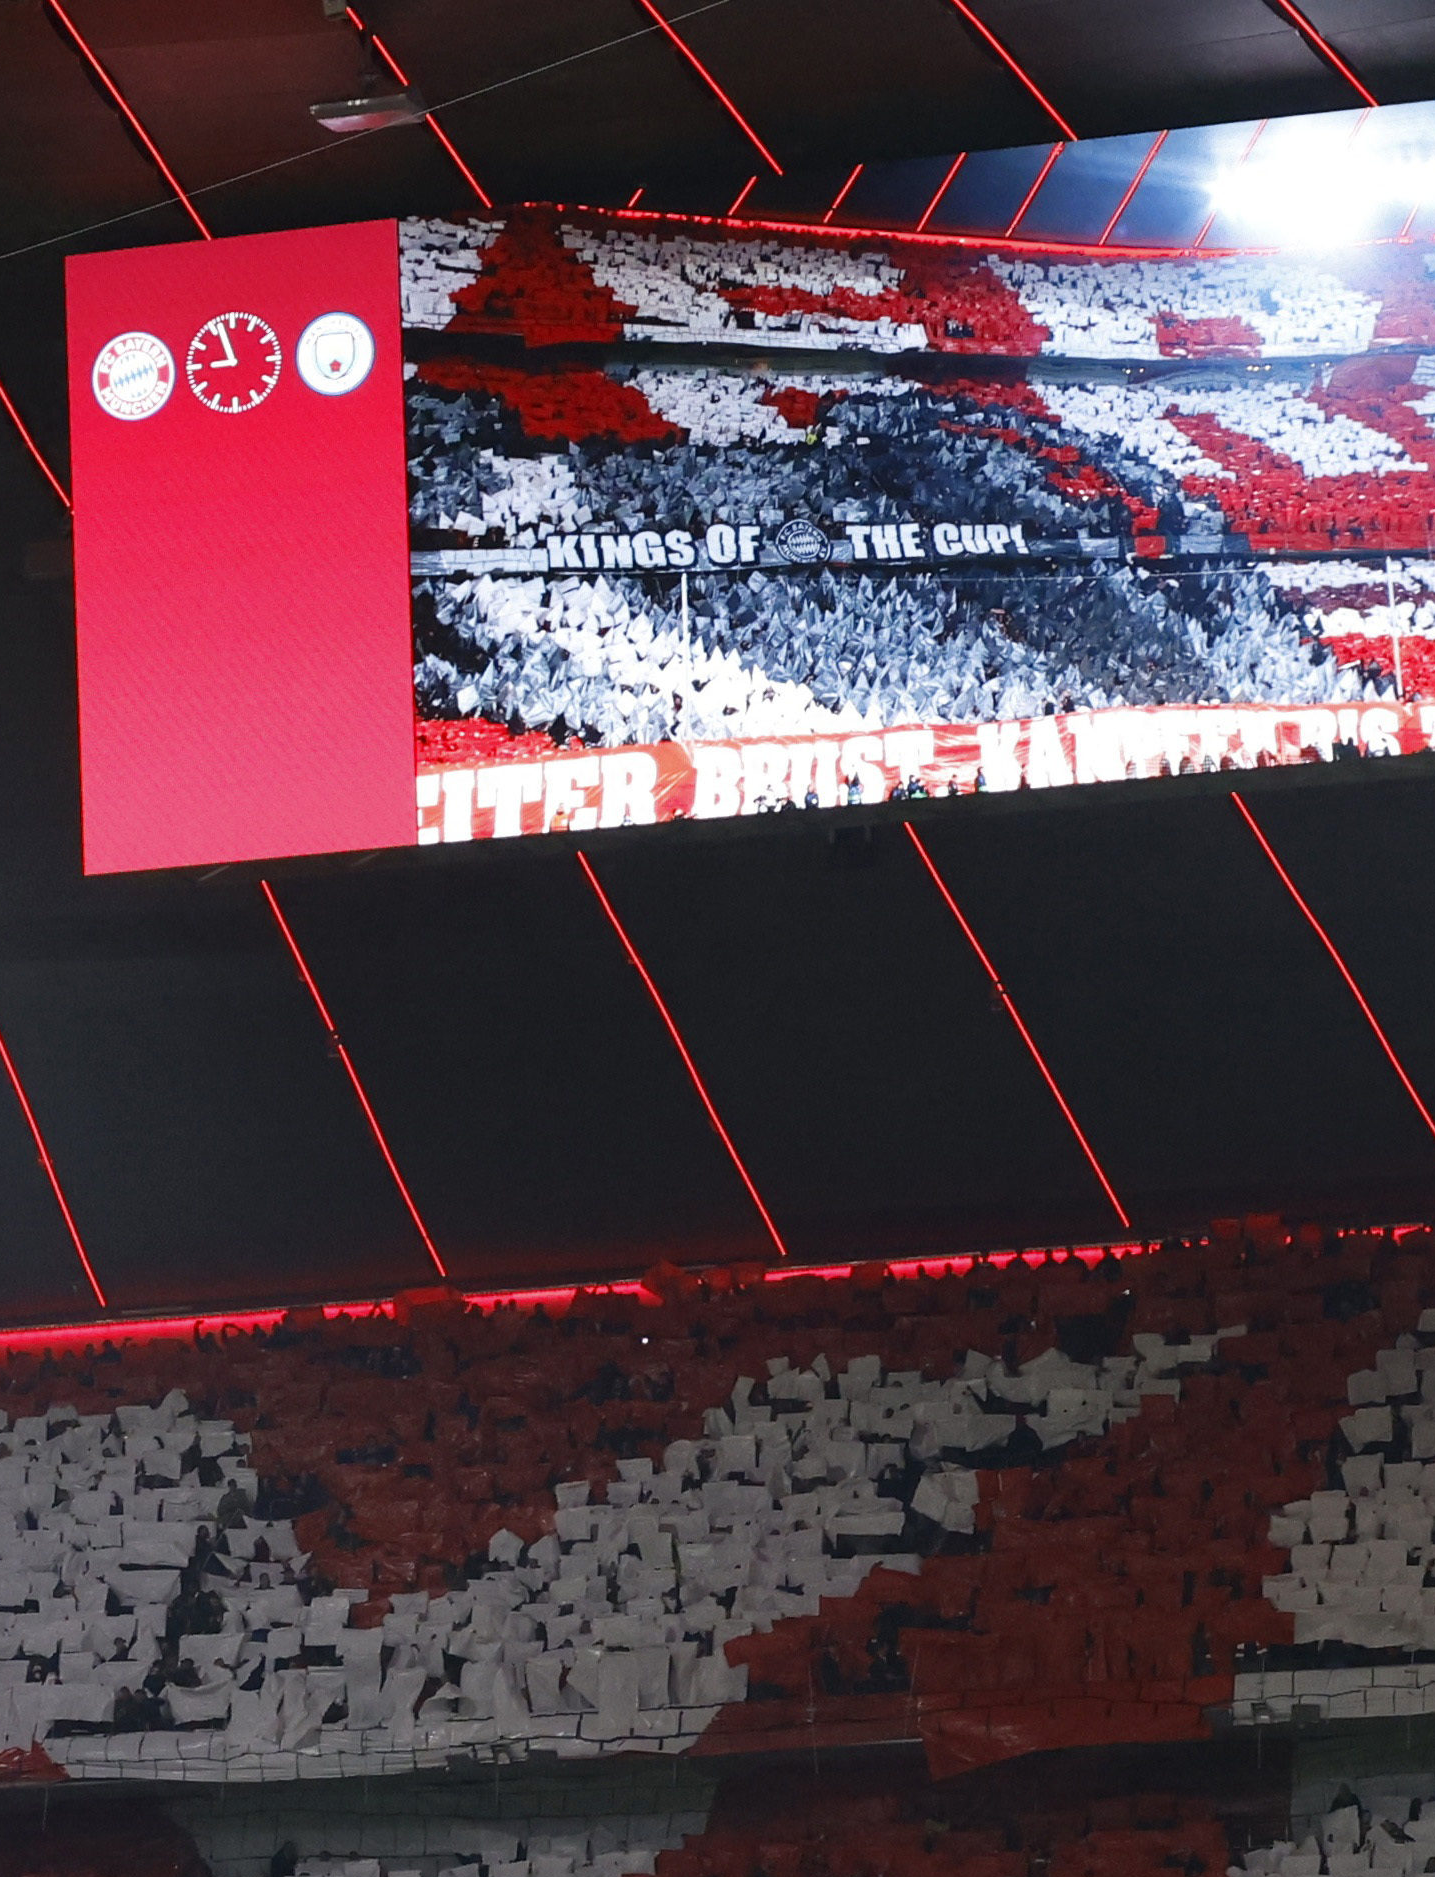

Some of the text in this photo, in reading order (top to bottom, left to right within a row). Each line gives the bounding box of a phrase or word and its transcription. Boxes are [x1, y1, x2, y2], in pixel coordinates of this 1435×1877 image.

[547, 528, 696, 569] KINGS
[706, 523, 762, 565] OF
[845, 522, 926, 561] THE
[932, 521, 1030, 557] CUP!
